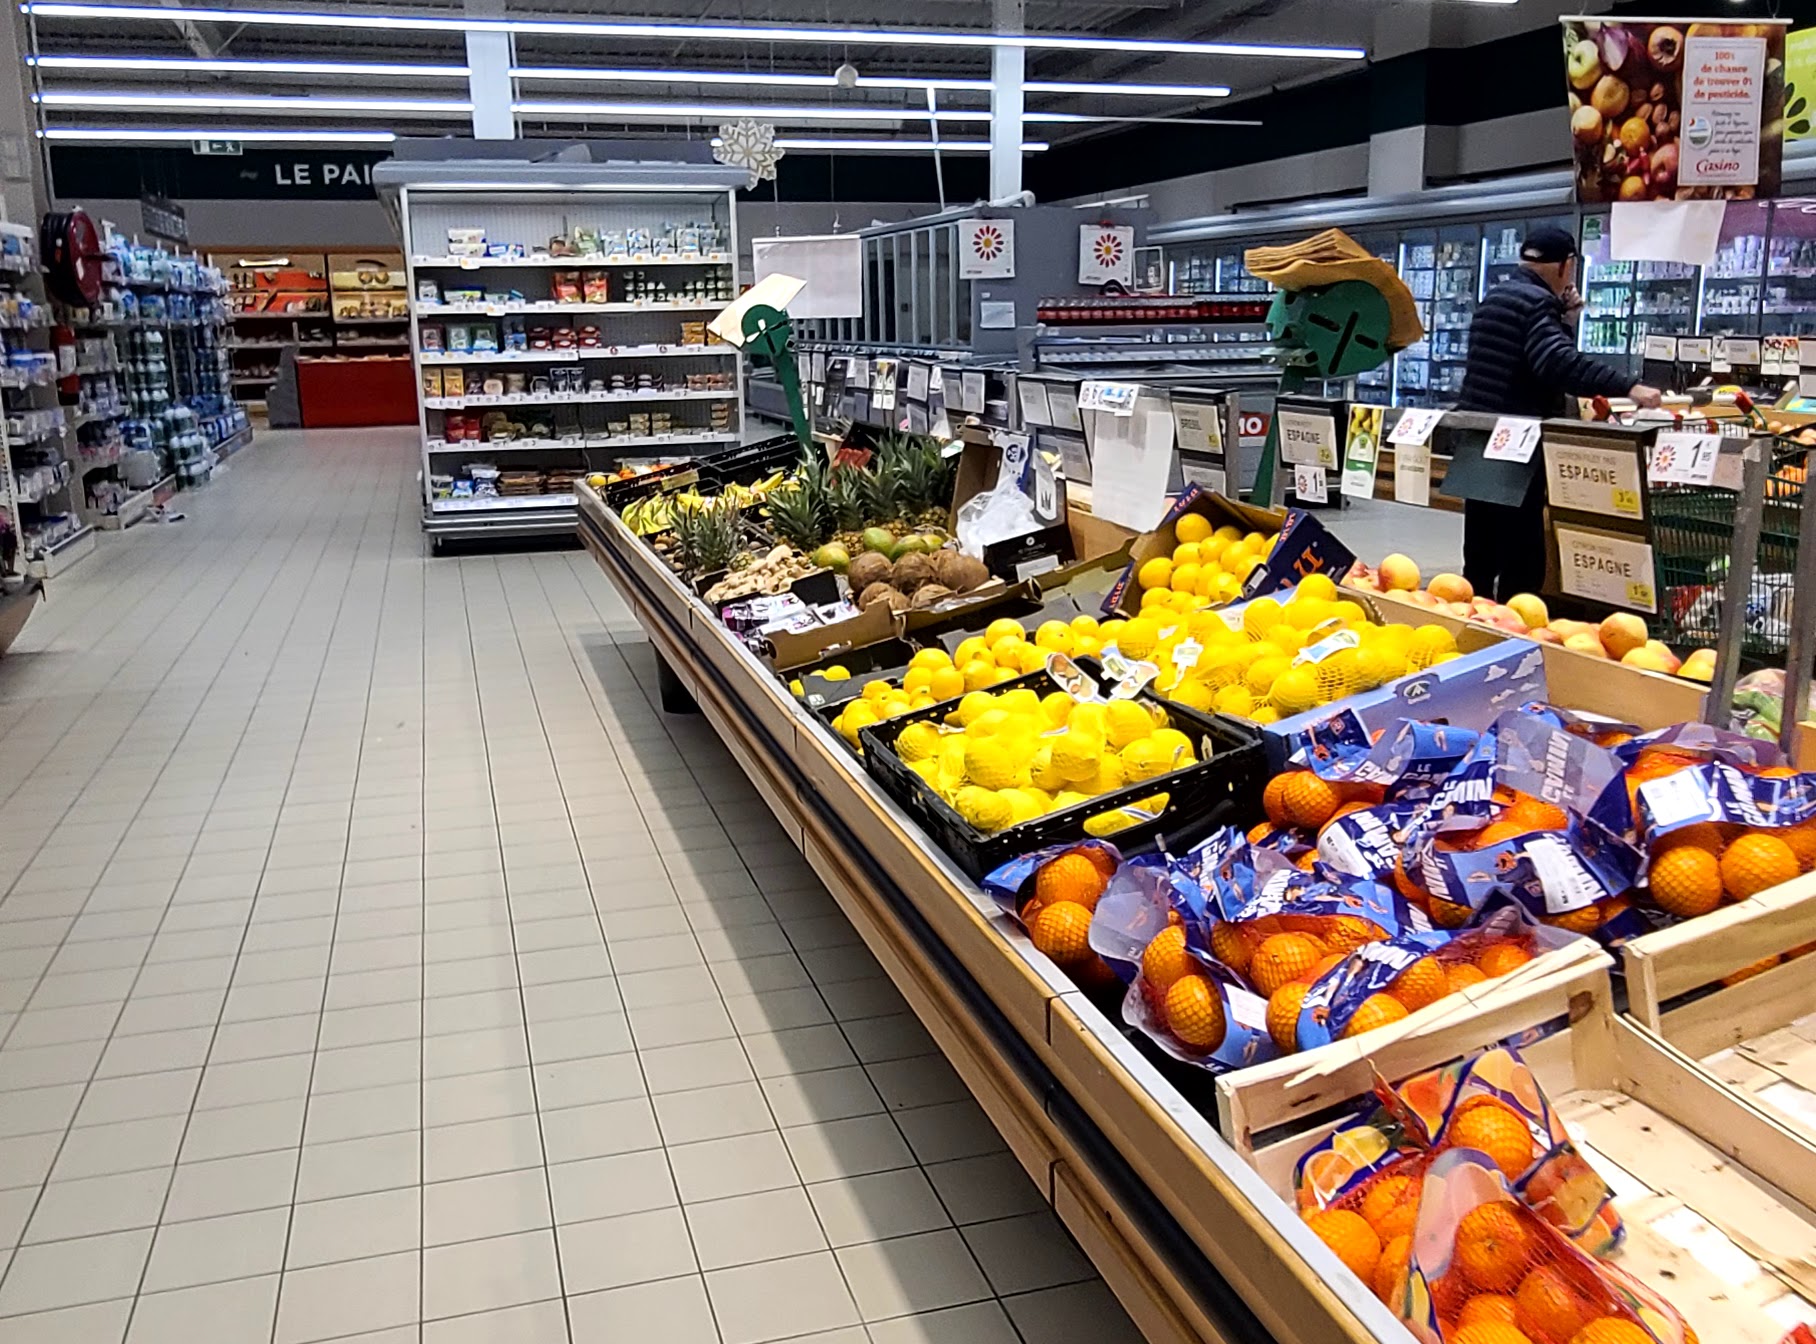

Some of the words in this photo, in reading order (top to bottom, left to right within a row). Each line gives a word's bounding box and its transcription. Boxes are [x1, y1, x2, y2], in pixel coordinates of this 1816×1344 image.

[1701, 64, 1712, 73] de
[1715, 65, 1748, 73] chance
[1693, 77, 1704, 86] de
[1707, 77, 1740, 86] trouver
[1694, 90, 1705, 99] de
[275, 164, 311, 184] LE
[323, 164, 371, 184] PAI
[1696, 158, 1740, 174] Casino
[1518, 425, 1533, 448] 1
[1691, 440, 1703, 468] 1
[1558, 463, 1617, 485] ESPAGNE
[1574, 553, 1632, 577] ESPAGNE
[1417, 763, 1431, 772] LE
